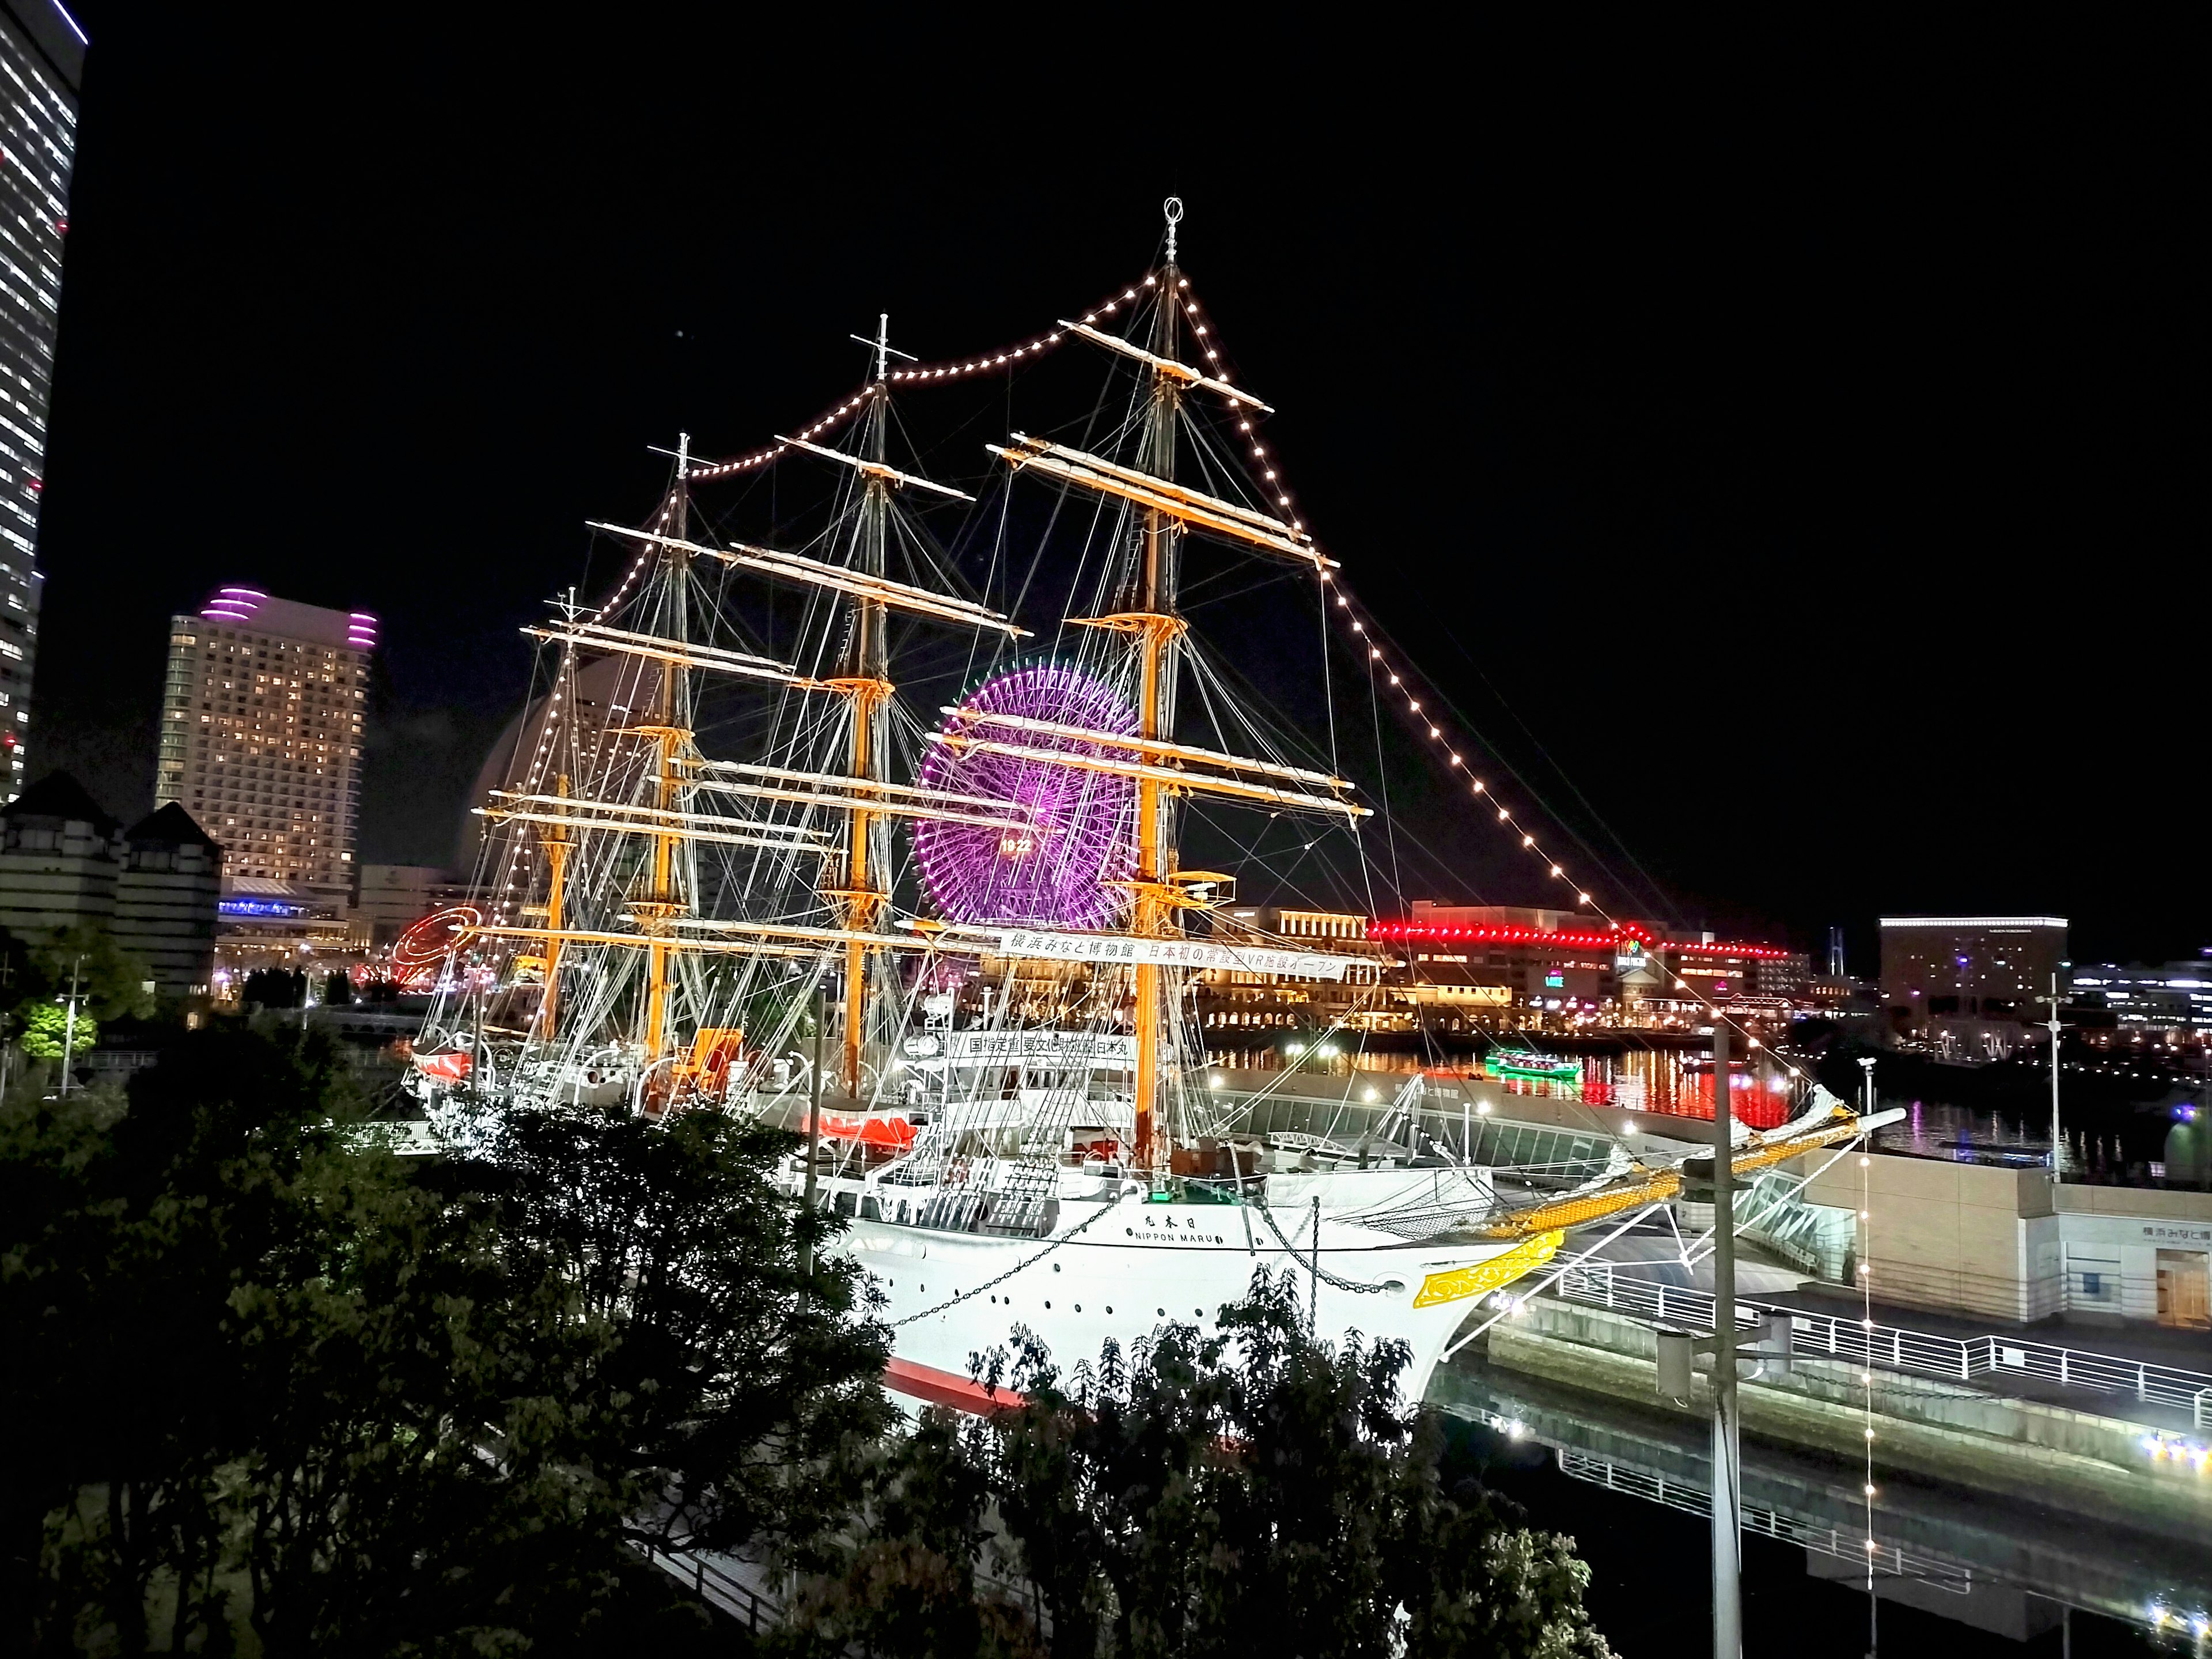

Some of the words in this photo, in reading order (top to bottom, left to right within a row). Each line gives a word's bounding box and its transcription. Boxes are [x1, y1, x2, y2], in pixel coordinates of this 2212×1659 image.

[1002, 839, 1031, 852] 19:22
[1010, 932, 1135, 957] 横浜みなと博物館
[1135, 1232, 1175, 1241] NIPPON
